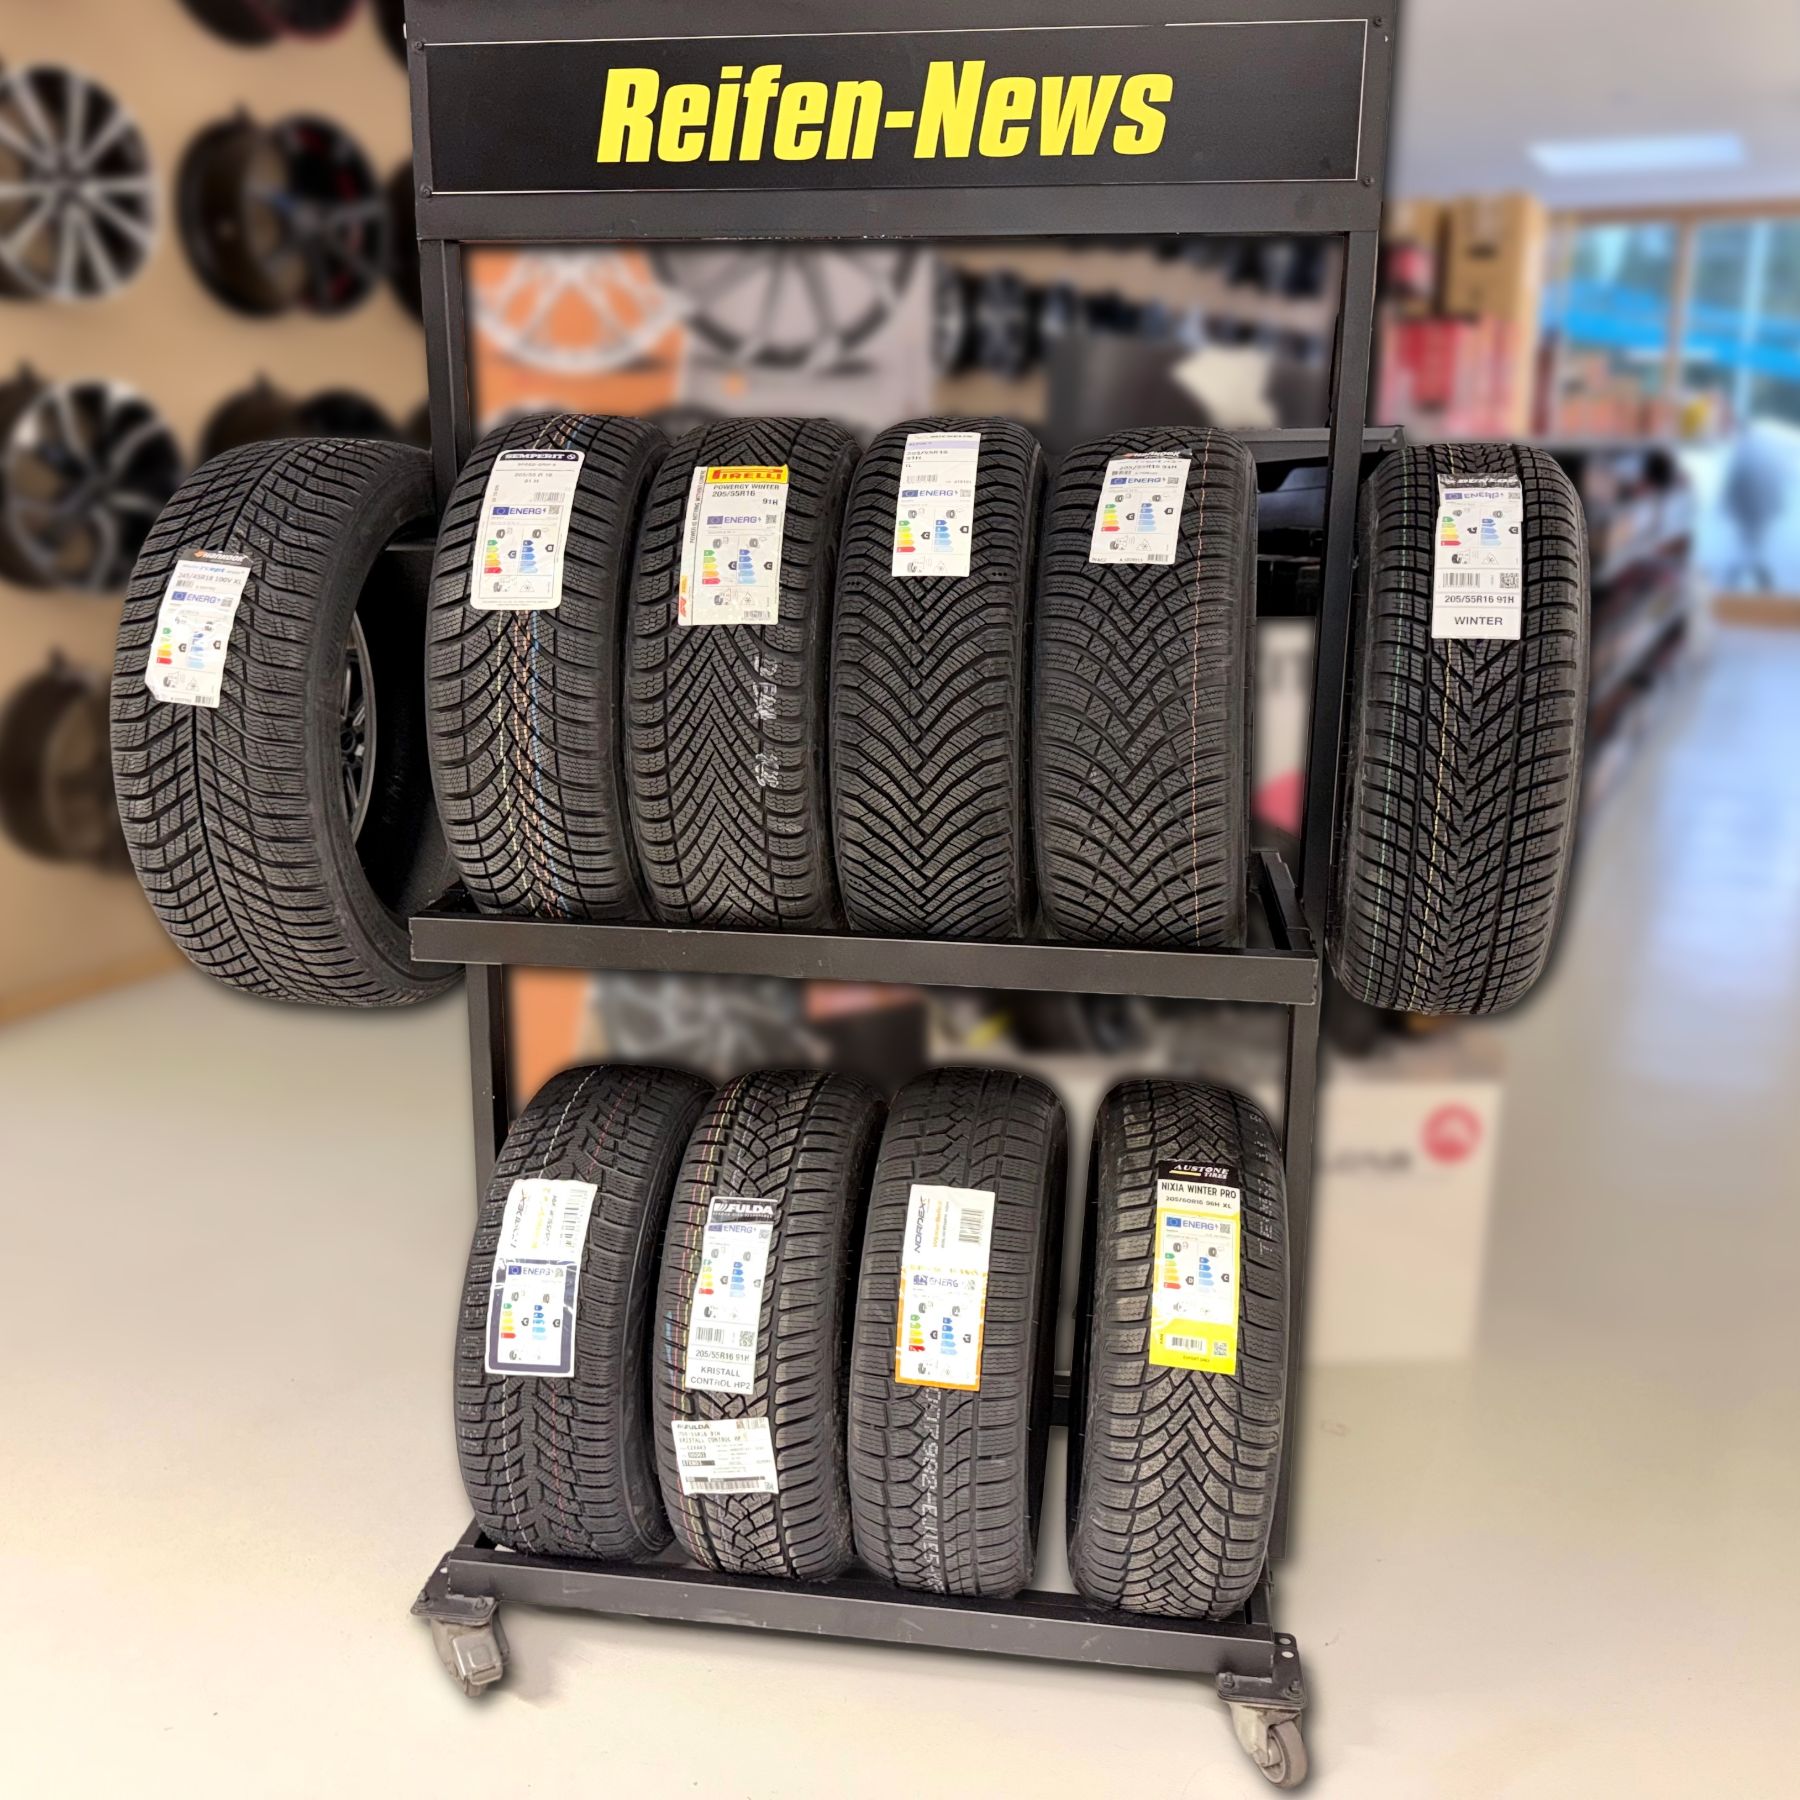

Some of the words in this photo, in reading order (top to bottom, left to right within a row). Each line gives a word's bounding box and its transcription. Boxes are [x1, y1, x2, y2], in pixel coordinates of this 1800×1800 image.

[597, 61, 1172, 162] Reifen-News
[712, 469, 783, 480] PIRELLI
[920, 489, 953, 497] ENERG
[762, 498, 778, 506] 91H
[509, 507, 542, 515] ENERG
[186, 593, 217, 604] ENERG
[1444, 595, 1494, 604] 205/55R16
[1496, 595, 1514, 604] 91H
[1454, 616, 1503, 625] WINTER
[1173, 1164, 1229, 1175] AUSTONE
[1161, 1182, 1184, 1192] NIXIA
[1187, 1185, 1217, 1196] WINTER
[1220, 1188, 1237, 1199] PRO
[724, 1203, 774, 1215] FULDA
[723, 1225, 752, 1234] ENERG
[914, 1195, 926, 1253] NORDEX
[1182, 1220, 1214, 1230] ENERG
[929, 1277, 959, 1287] ENERG
[695, 1350, 734, 1361] 205/55R16
[701, 1366, 740, 1377] KRISTALL
[690, 1376, 732, 1388] CONTROL
[734, 1381, 751, 1390] HP2
